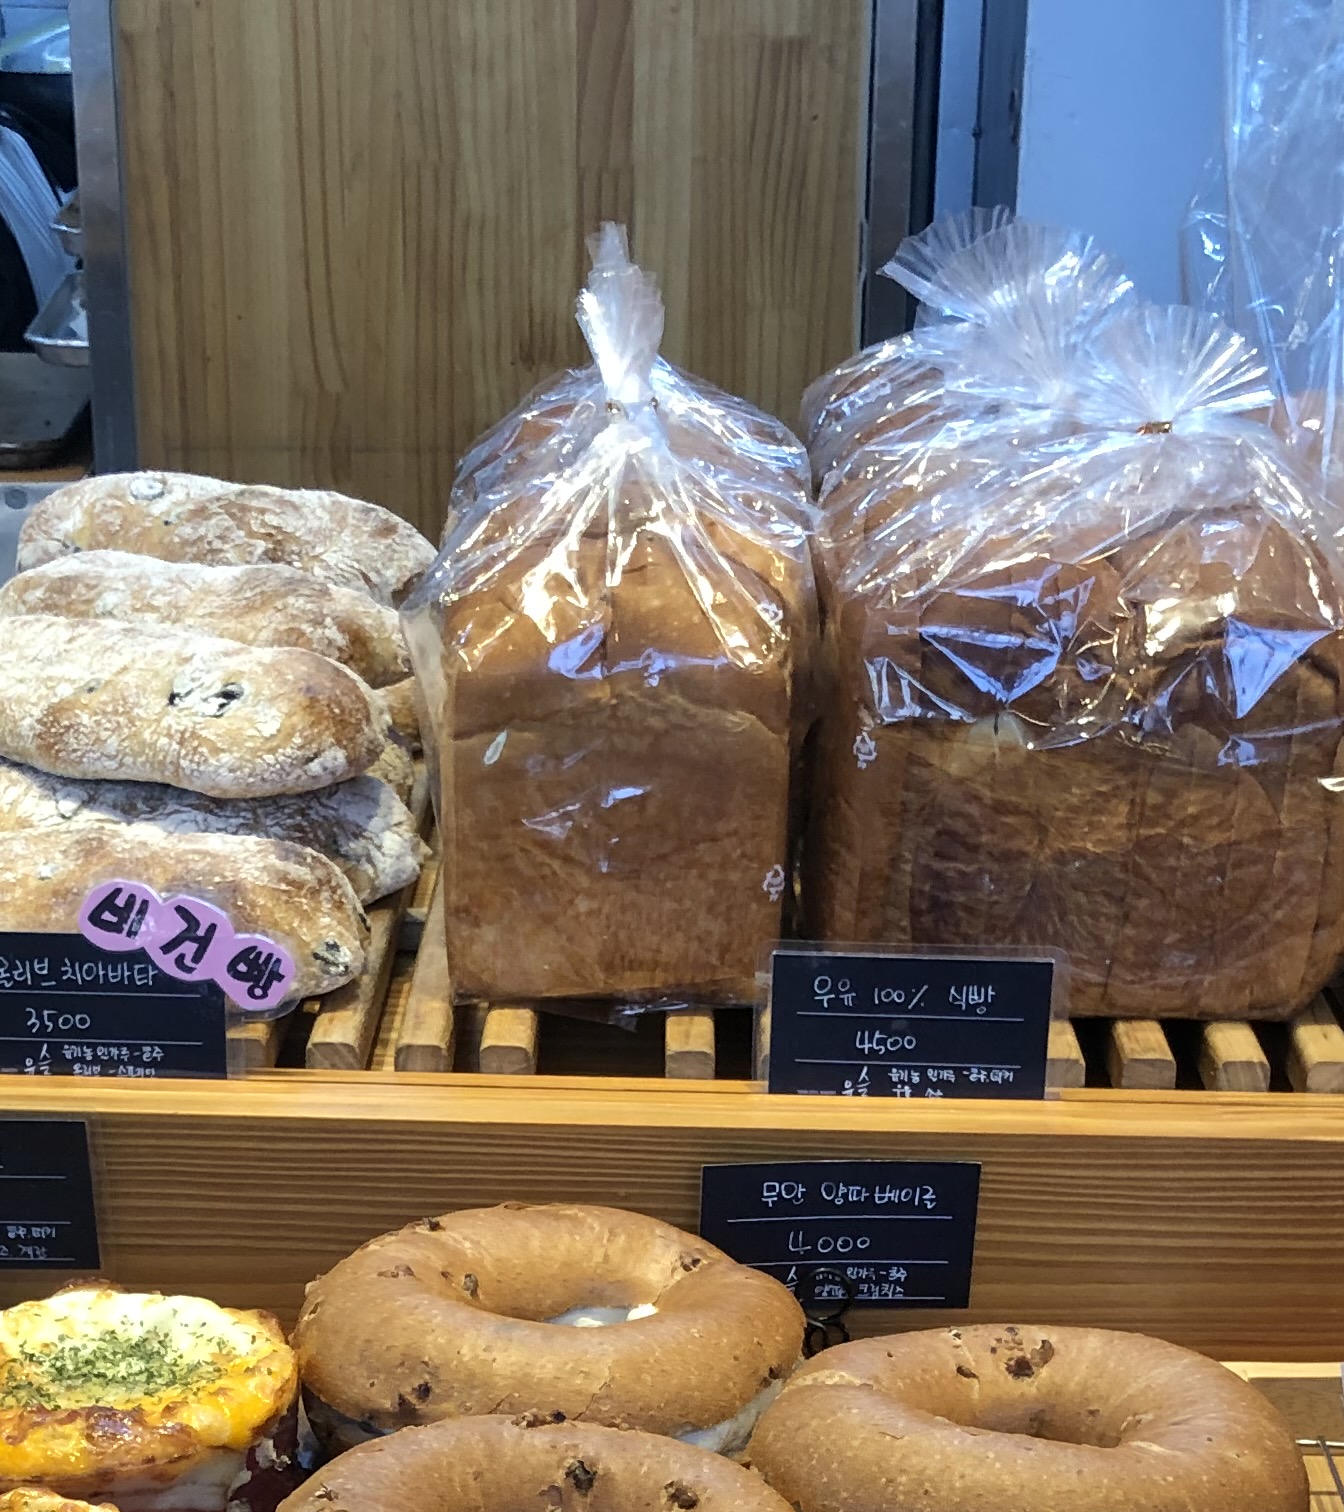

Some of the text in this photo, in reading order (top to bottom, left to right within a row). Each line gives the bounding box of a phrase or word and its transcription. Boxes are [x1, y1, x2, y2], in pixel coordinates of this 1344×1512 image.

[87, 887, 285, 1000] 비건빵
[61, 956, 158, 987] 치아바타
[814, 974, 996, 1015] 우유 100% 식빵
[26, 1006, 91, 1034] 3500
[855, 1029, 916, 1056] 4500
[761, 1181, 807, 1207] 무안
[789, 1230, 872, 1256] 4000
